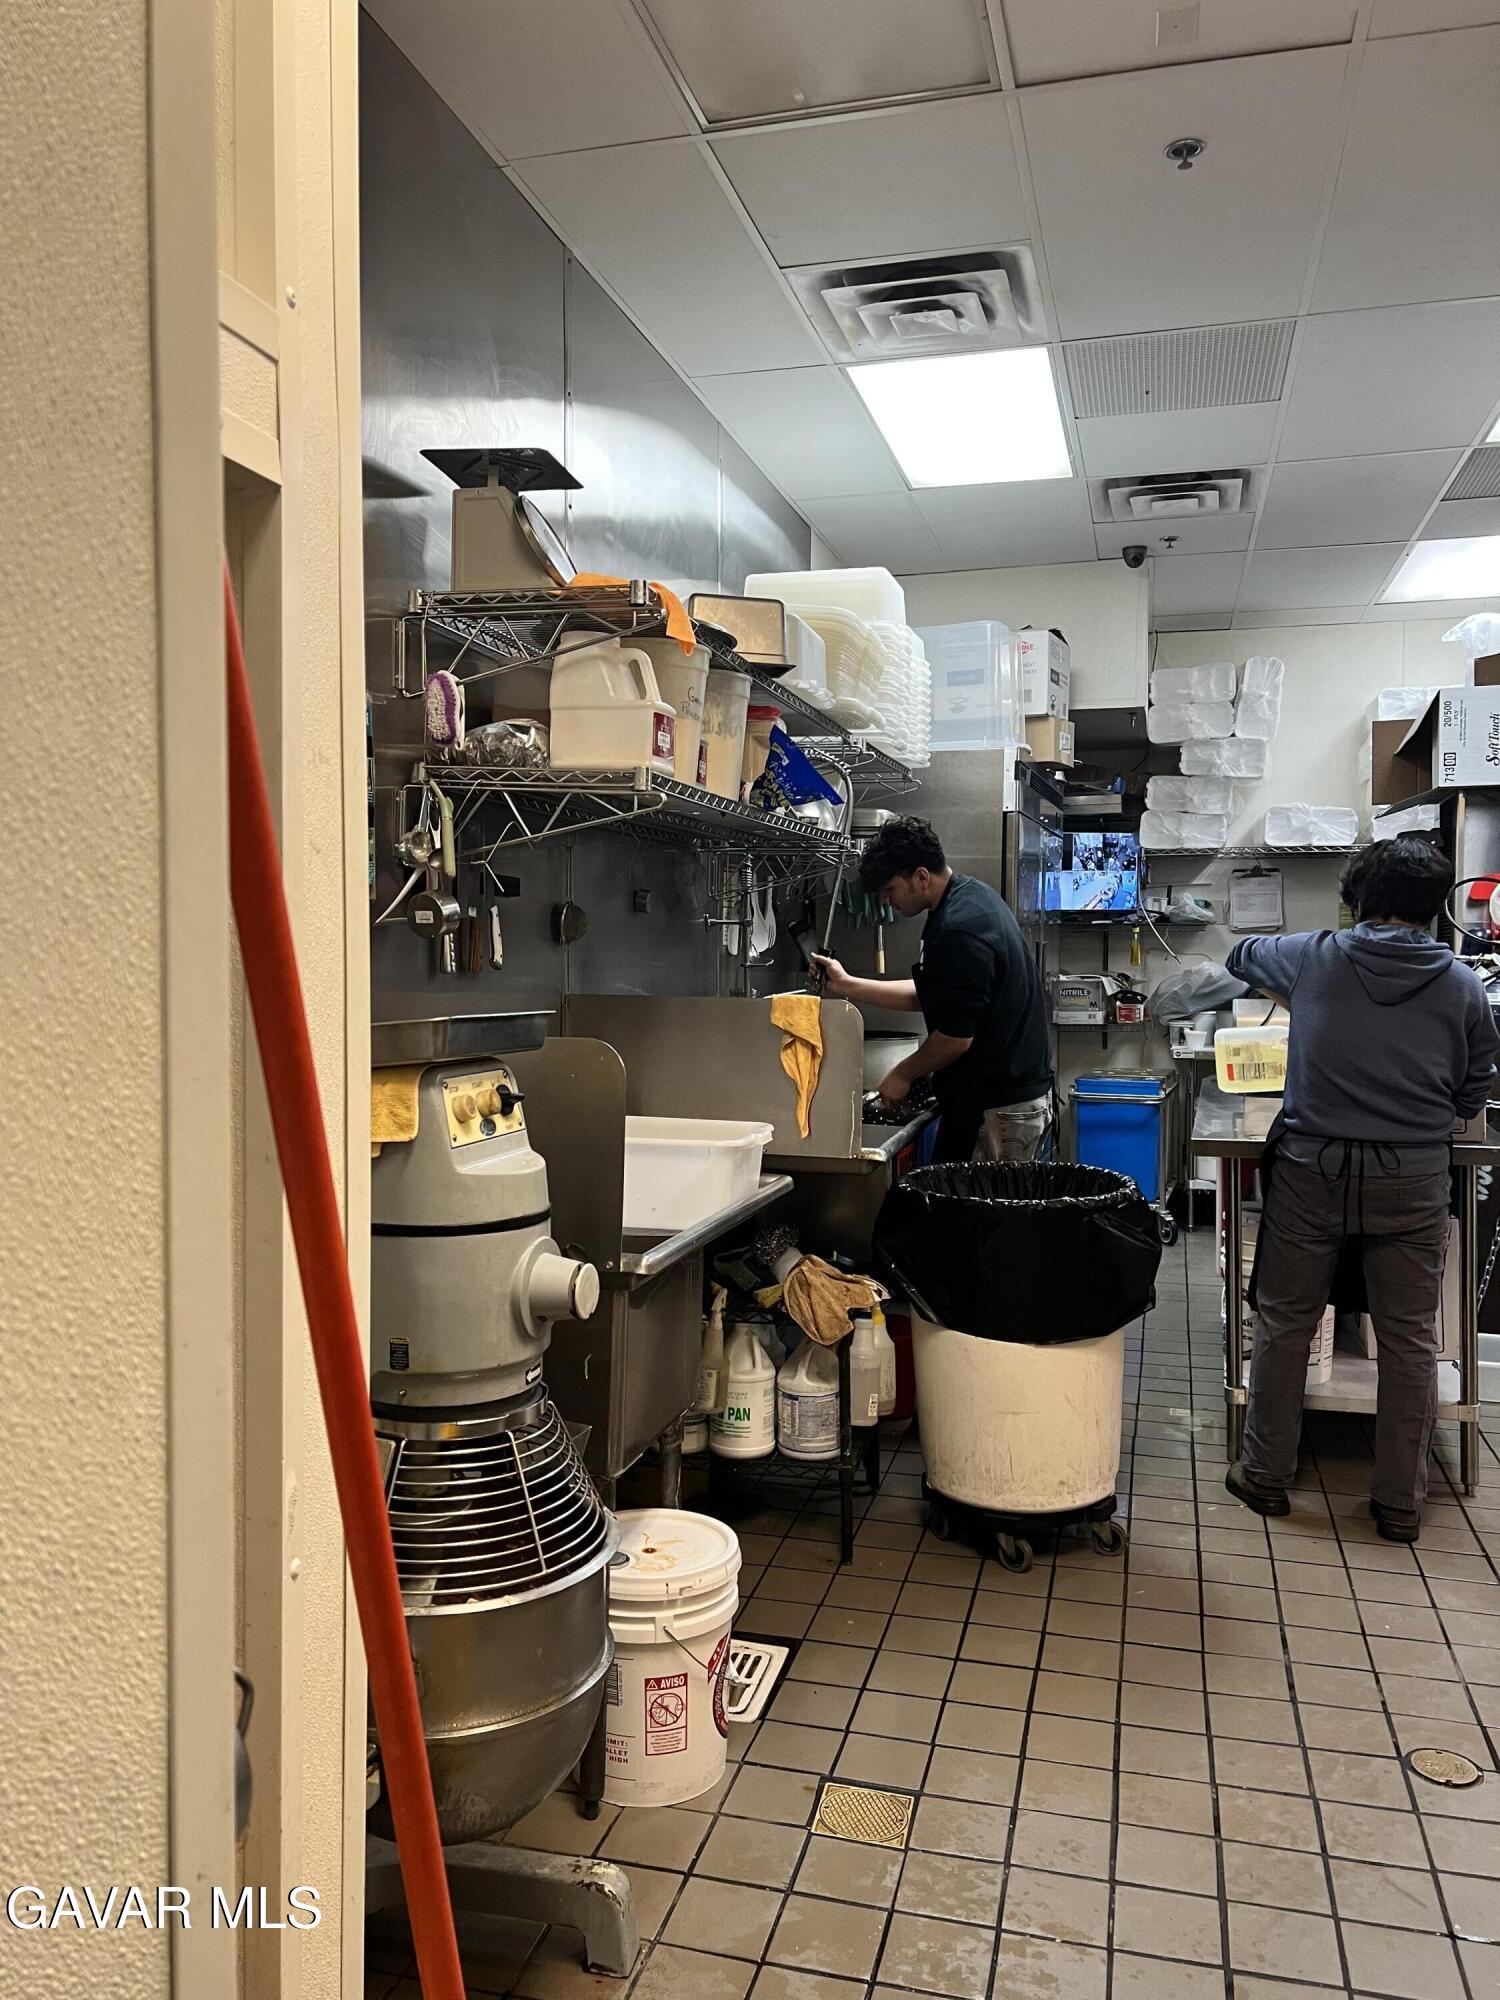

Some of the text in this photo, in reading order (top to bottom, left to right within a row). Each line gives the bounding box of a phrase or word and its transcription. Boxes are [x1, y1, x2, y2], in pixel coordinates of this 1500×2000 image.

[1443, 701, 1452, 727] 20/500
[1444, 752, 1456, 783] 71300
[728, 1407, 751, 1421] PAN
[660, 1676, 685, 1689] AVISO
[607, 1738, 628, 1747] IMIT:
[604, 1747, 628, 1756] ALLET
[609, 1755, 628, 1763] HIGH
